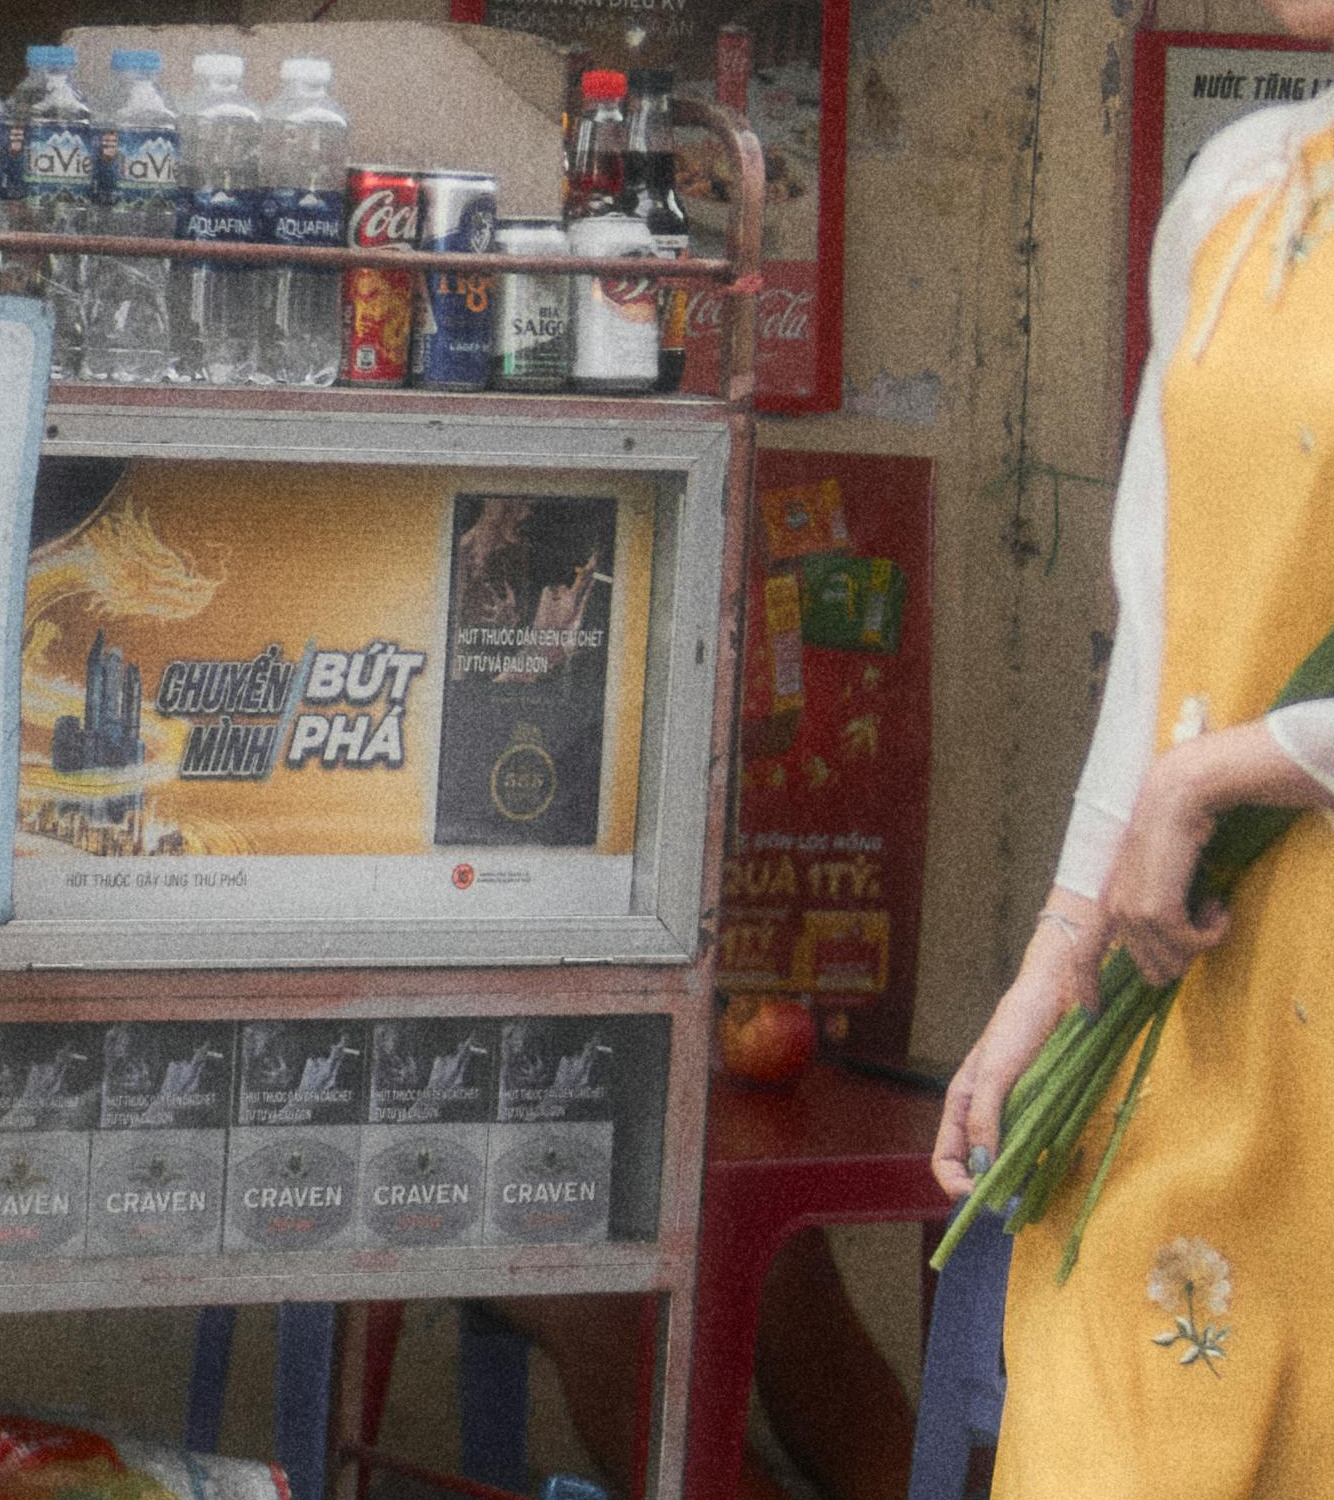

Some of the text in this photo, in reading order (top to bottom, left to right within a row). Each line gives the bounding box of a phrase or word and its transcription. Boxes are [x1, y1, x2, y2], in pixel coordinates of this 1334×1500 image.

[1193, 70, 1248, 100] NƯỚC
[154, 643, 294, 719] CHUYỂN
[180, 703, 406, 780] MÌNH PHÁ
[106, 1191, 207, 1214] CRAVEN
[243, 1186, 343, 1209] CRAVEN
[373, 1183, 470, 1206] CRAVEN
[502, 1181, 597, 1205] CRAVEN
